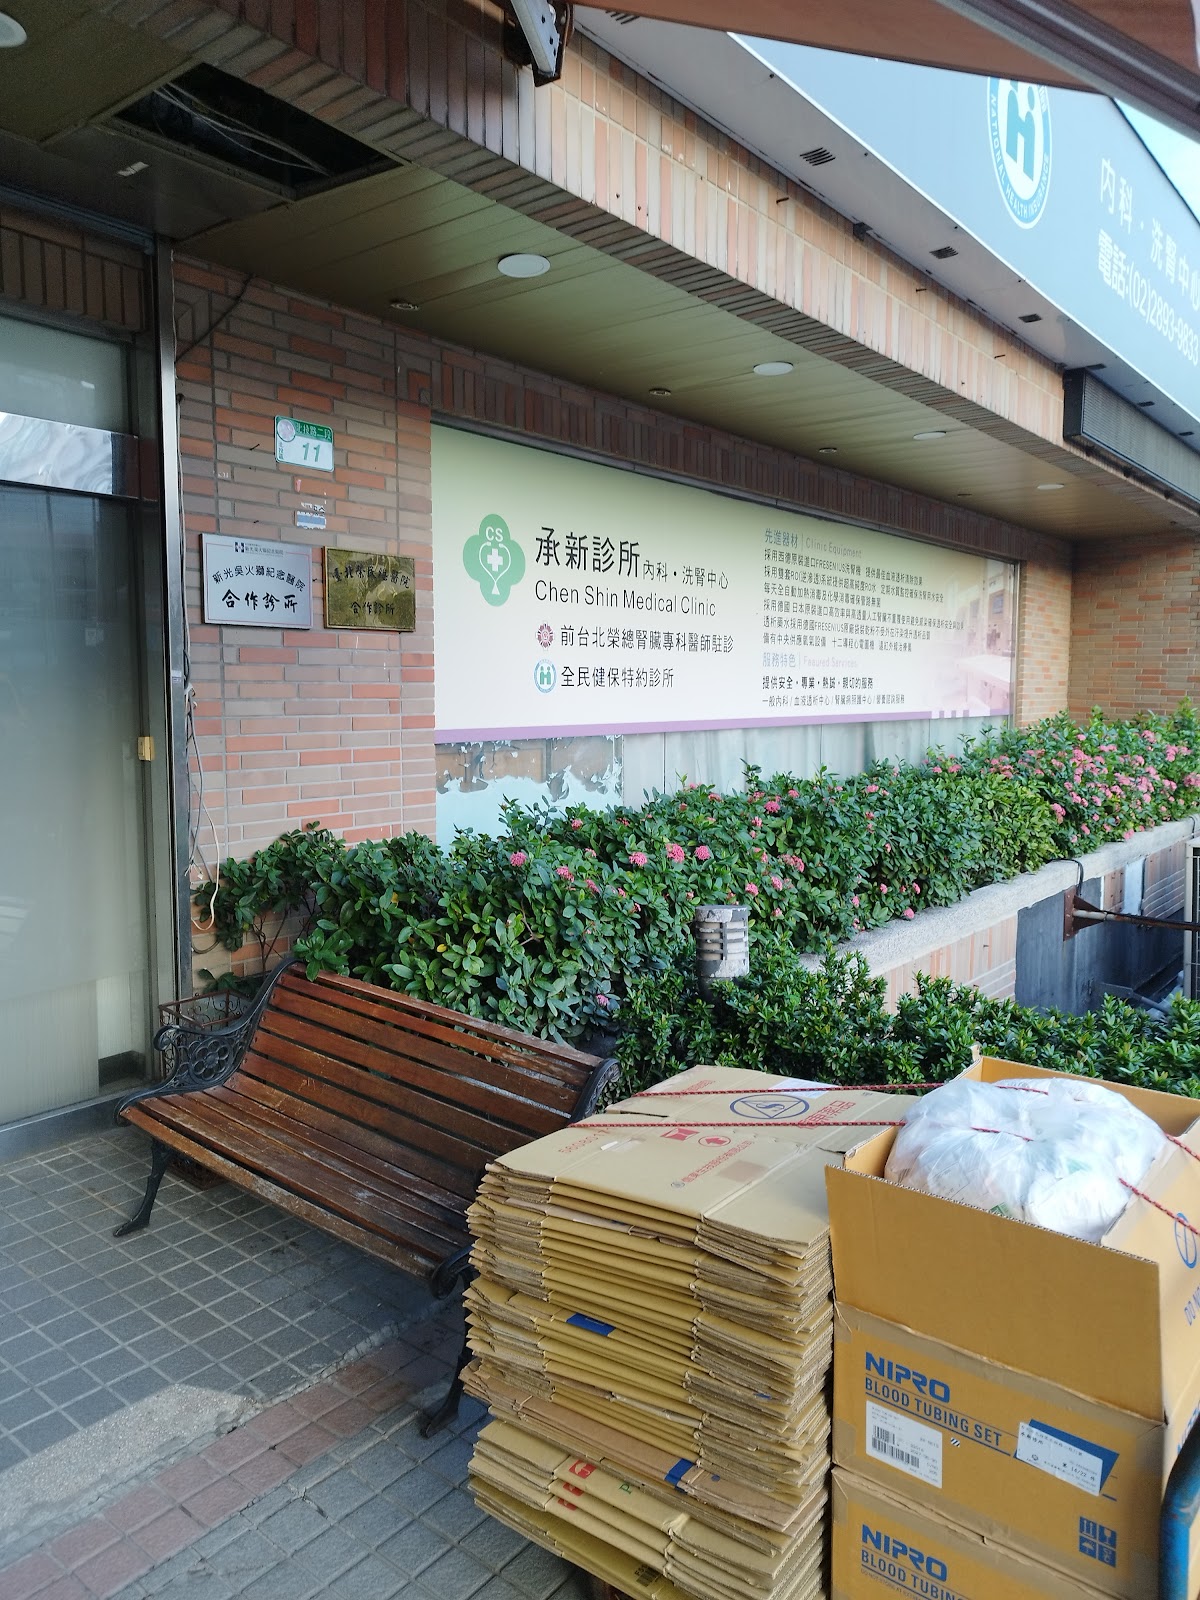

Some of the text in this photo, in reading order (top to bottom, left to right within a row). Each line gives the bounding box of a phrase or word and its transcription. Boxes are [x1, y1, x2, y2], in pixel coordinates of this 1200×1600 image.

[991, 93, 1006, 184] NATIONAL
[1006, 184, 1028, 218] HEALTH
[302, 442, 321, 462] 11
[485, 526, 503, 542] CS
[764, 528, 798, 549] 先進器材
[805, 537, 827, 552] Clinic
[535, 526, 640, 578] 承新診所
[212, 565, 306, 592] 新光吳火獅紀念醫院
[221, 588, 298, 613] 合作診所
[351, 602, 395, 615] 合作診所
[535, 580, 716, 617] Chen Shin Medical Clinic
[560, 624, 734, 653] 前台北榮總腎臟專科醫師駐診
[762, 652, 797, 668] 服務特色
[560, 665, 674, 688] 全民健保特約診所
[865, 1351, 950, 1403] NIPRO
[865, 1377, 910, 1407] BLOOD
[914, 1398, 969, 1433] TUBING
[974, 1423, 1003, 1446] SET
[862, 1524, 948, 1583] NIPRO
[862, 1549, 907, 1582] BLOOD
